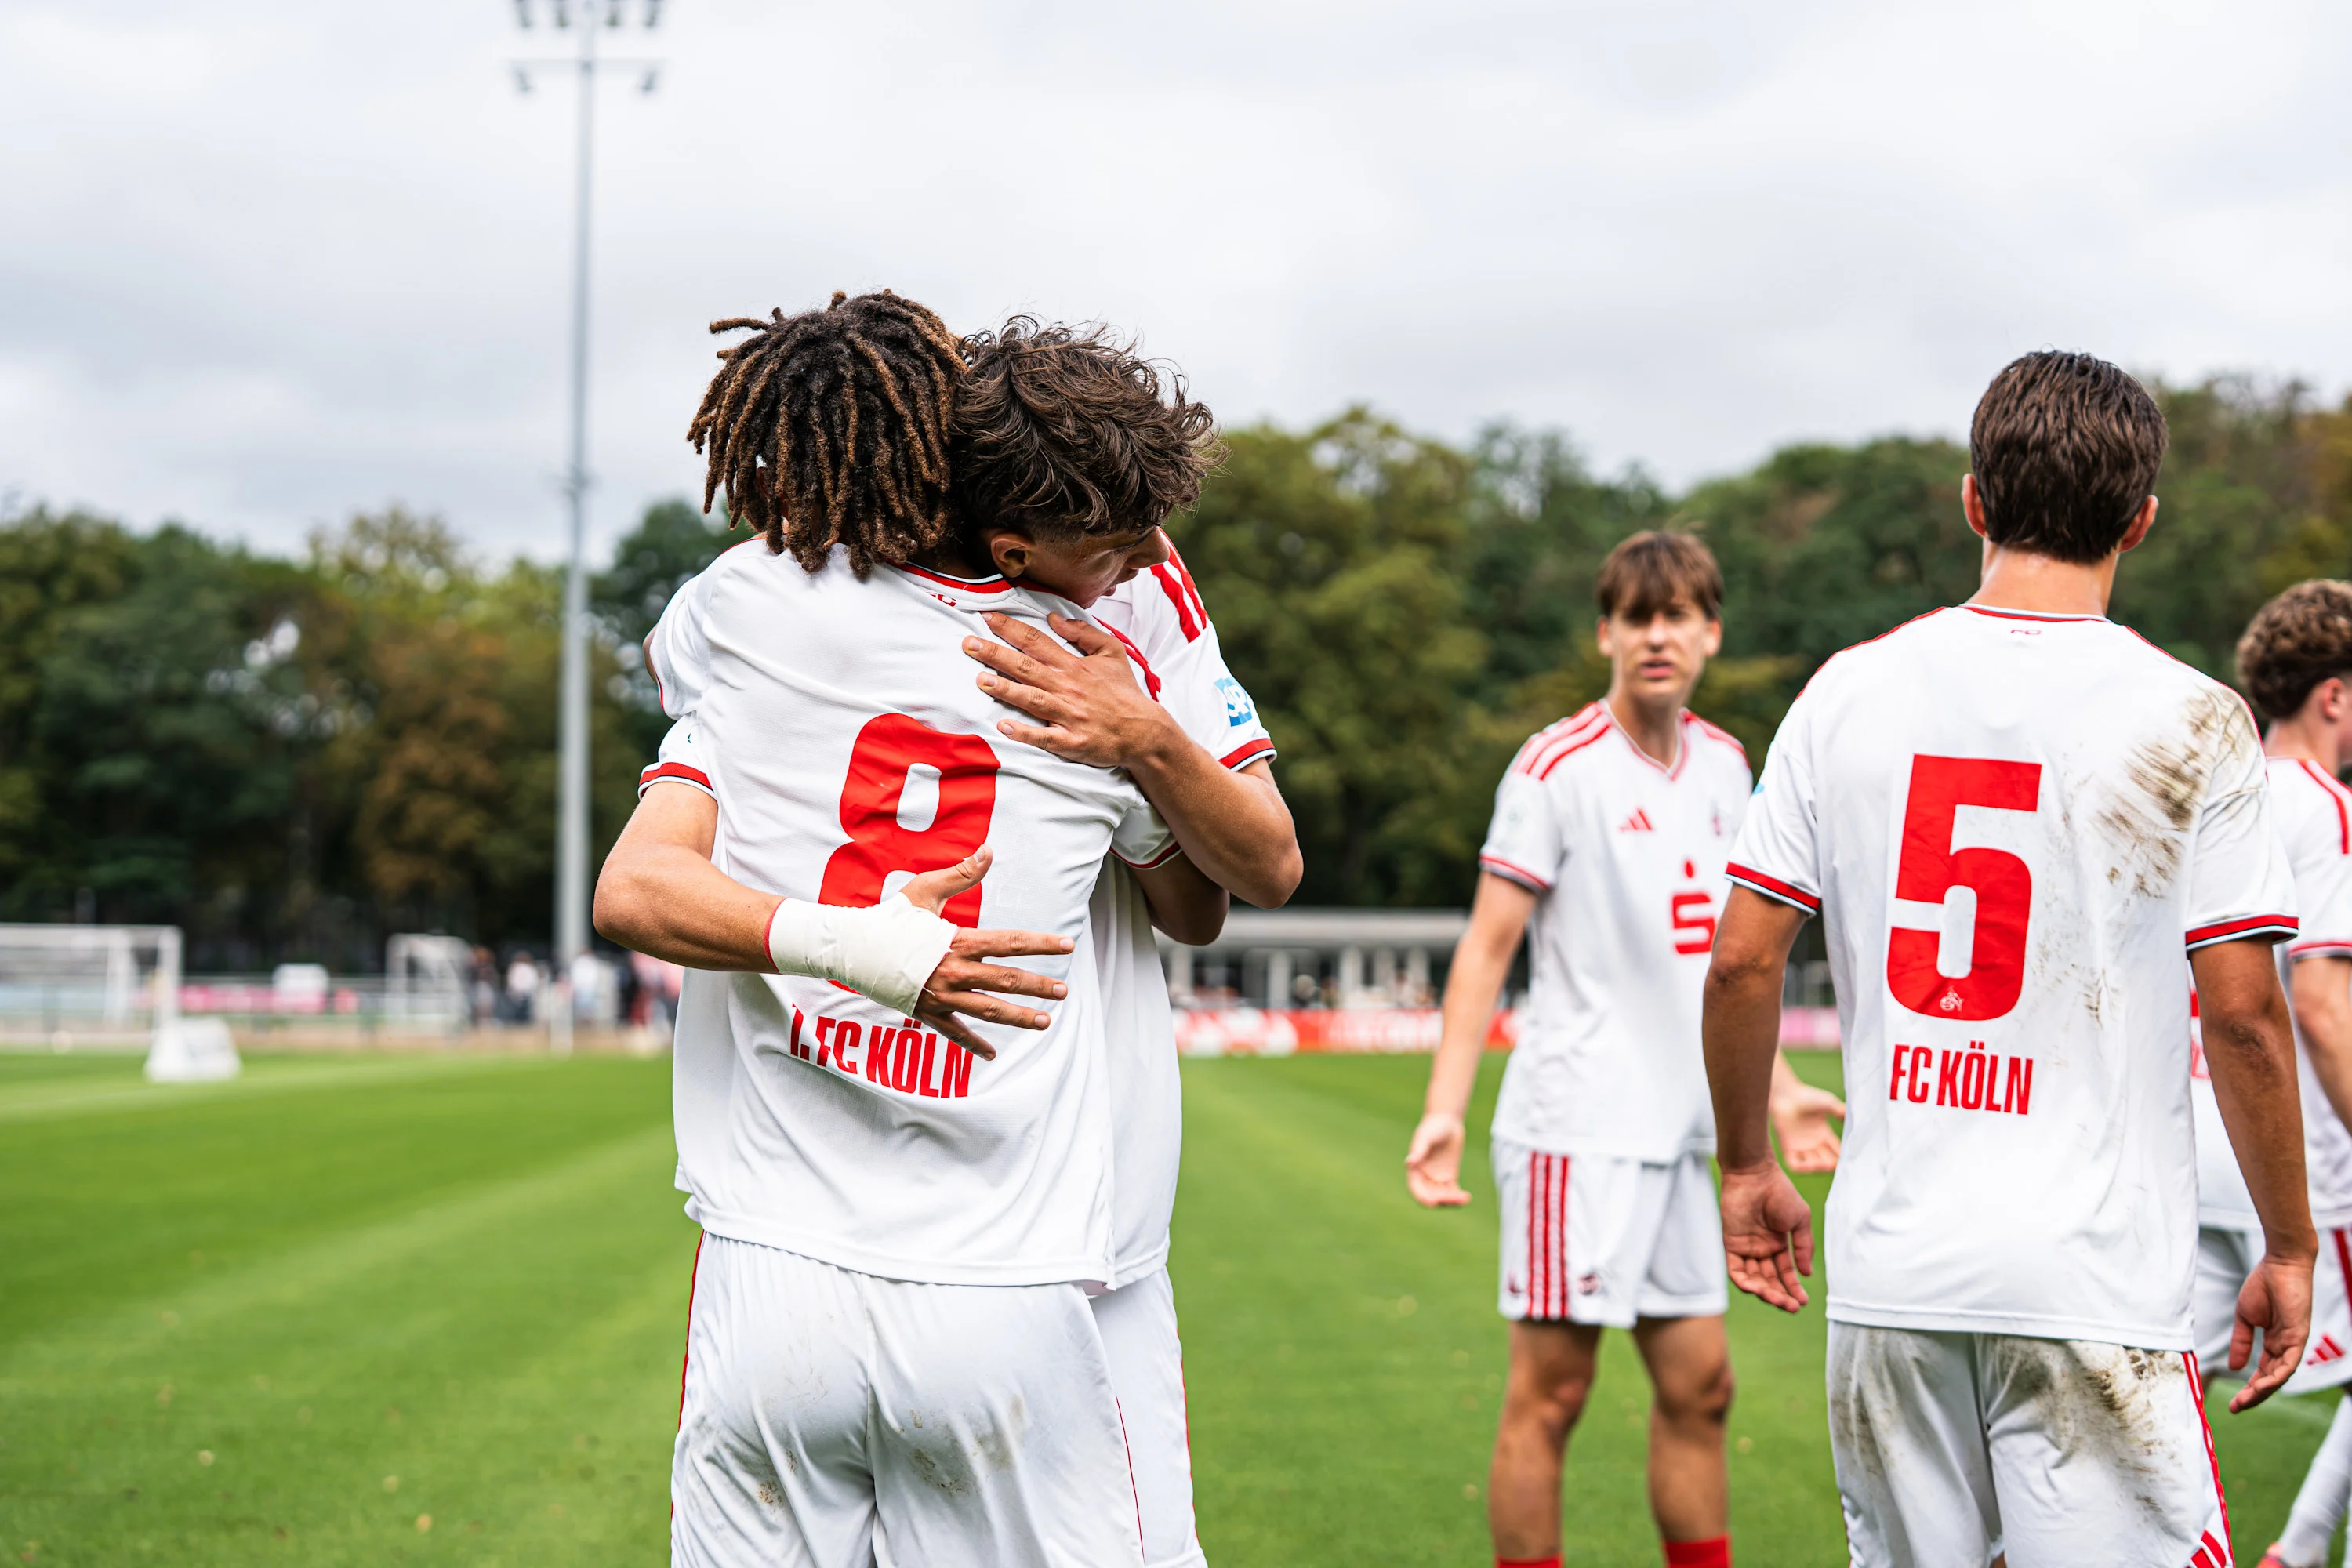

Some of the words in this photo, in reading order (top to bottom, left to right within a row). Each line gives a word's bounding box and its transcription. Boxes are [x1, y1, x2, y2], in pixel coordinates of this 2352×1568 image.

[818, 713, 1002, 996] 8
[1886, 753, 2042, 1022] 5
[815, 1015, 862, 1075] FC
[866, 1018, 974, 1098] KÖLN
[1889, 1044, 1933, 1104] FC
[1936, 1040, 2034, 1116] KÖLN
